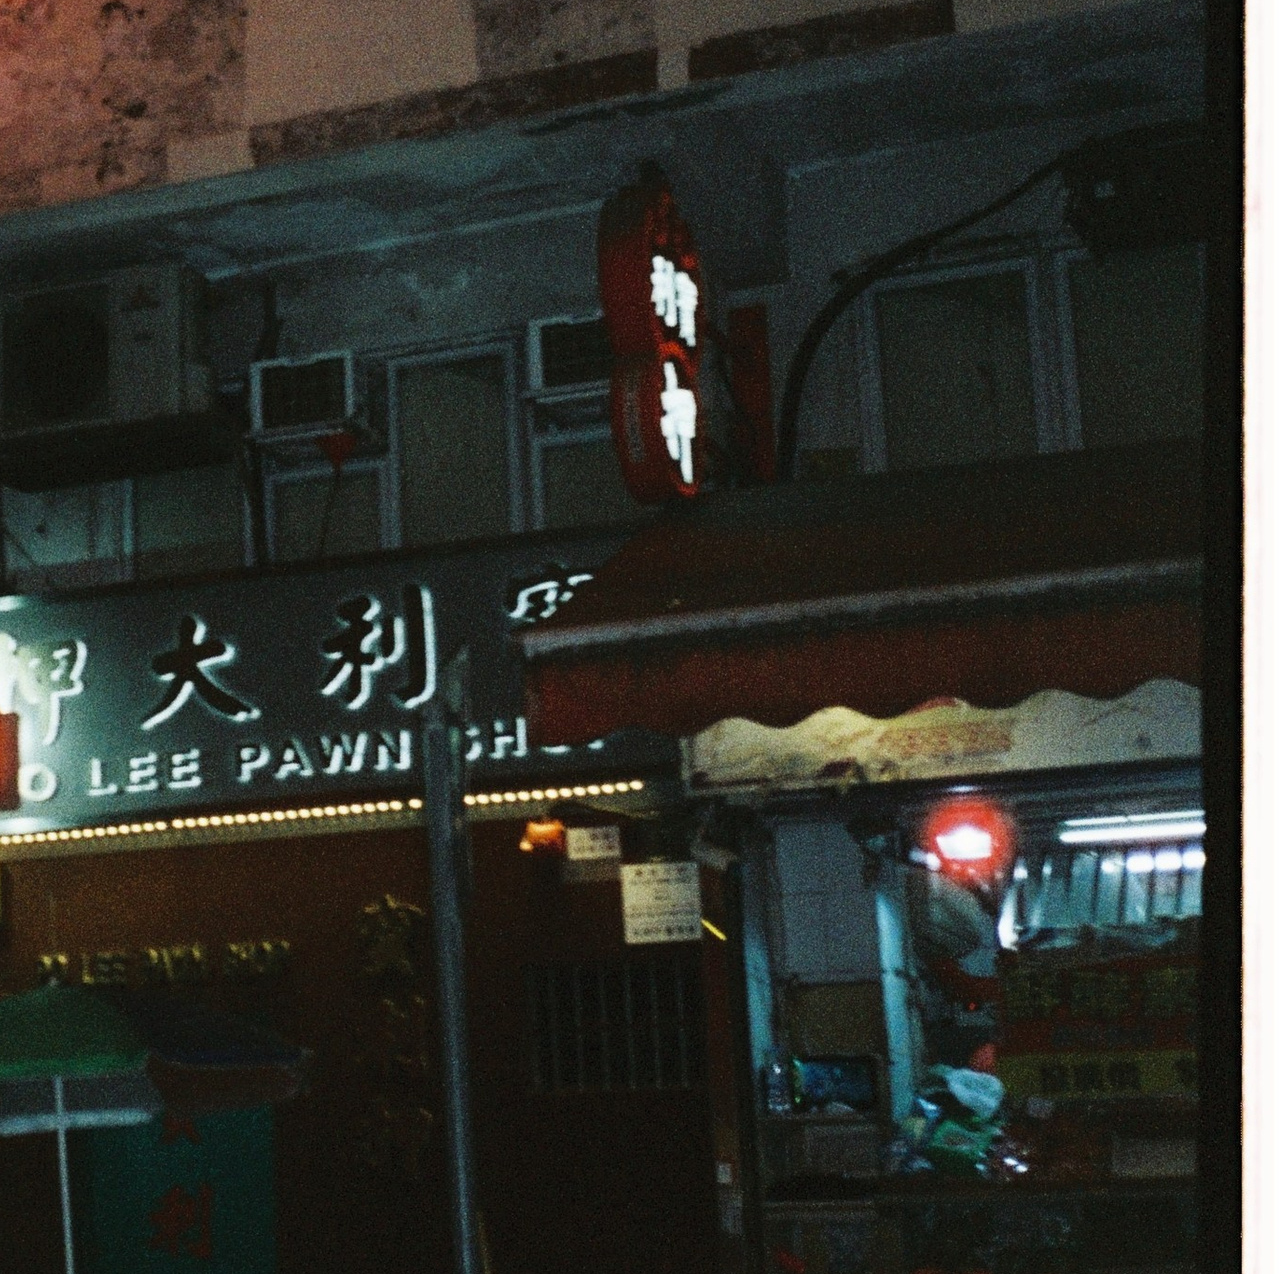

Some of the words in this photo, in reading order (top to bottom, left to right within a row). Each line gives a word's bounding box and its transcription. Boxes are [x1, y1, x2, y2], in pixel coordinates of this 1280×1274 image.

[19, 763, 57, 802] O
[87, 748, 202, 797] LEE
[239, 728, 412, 783] PAWN
